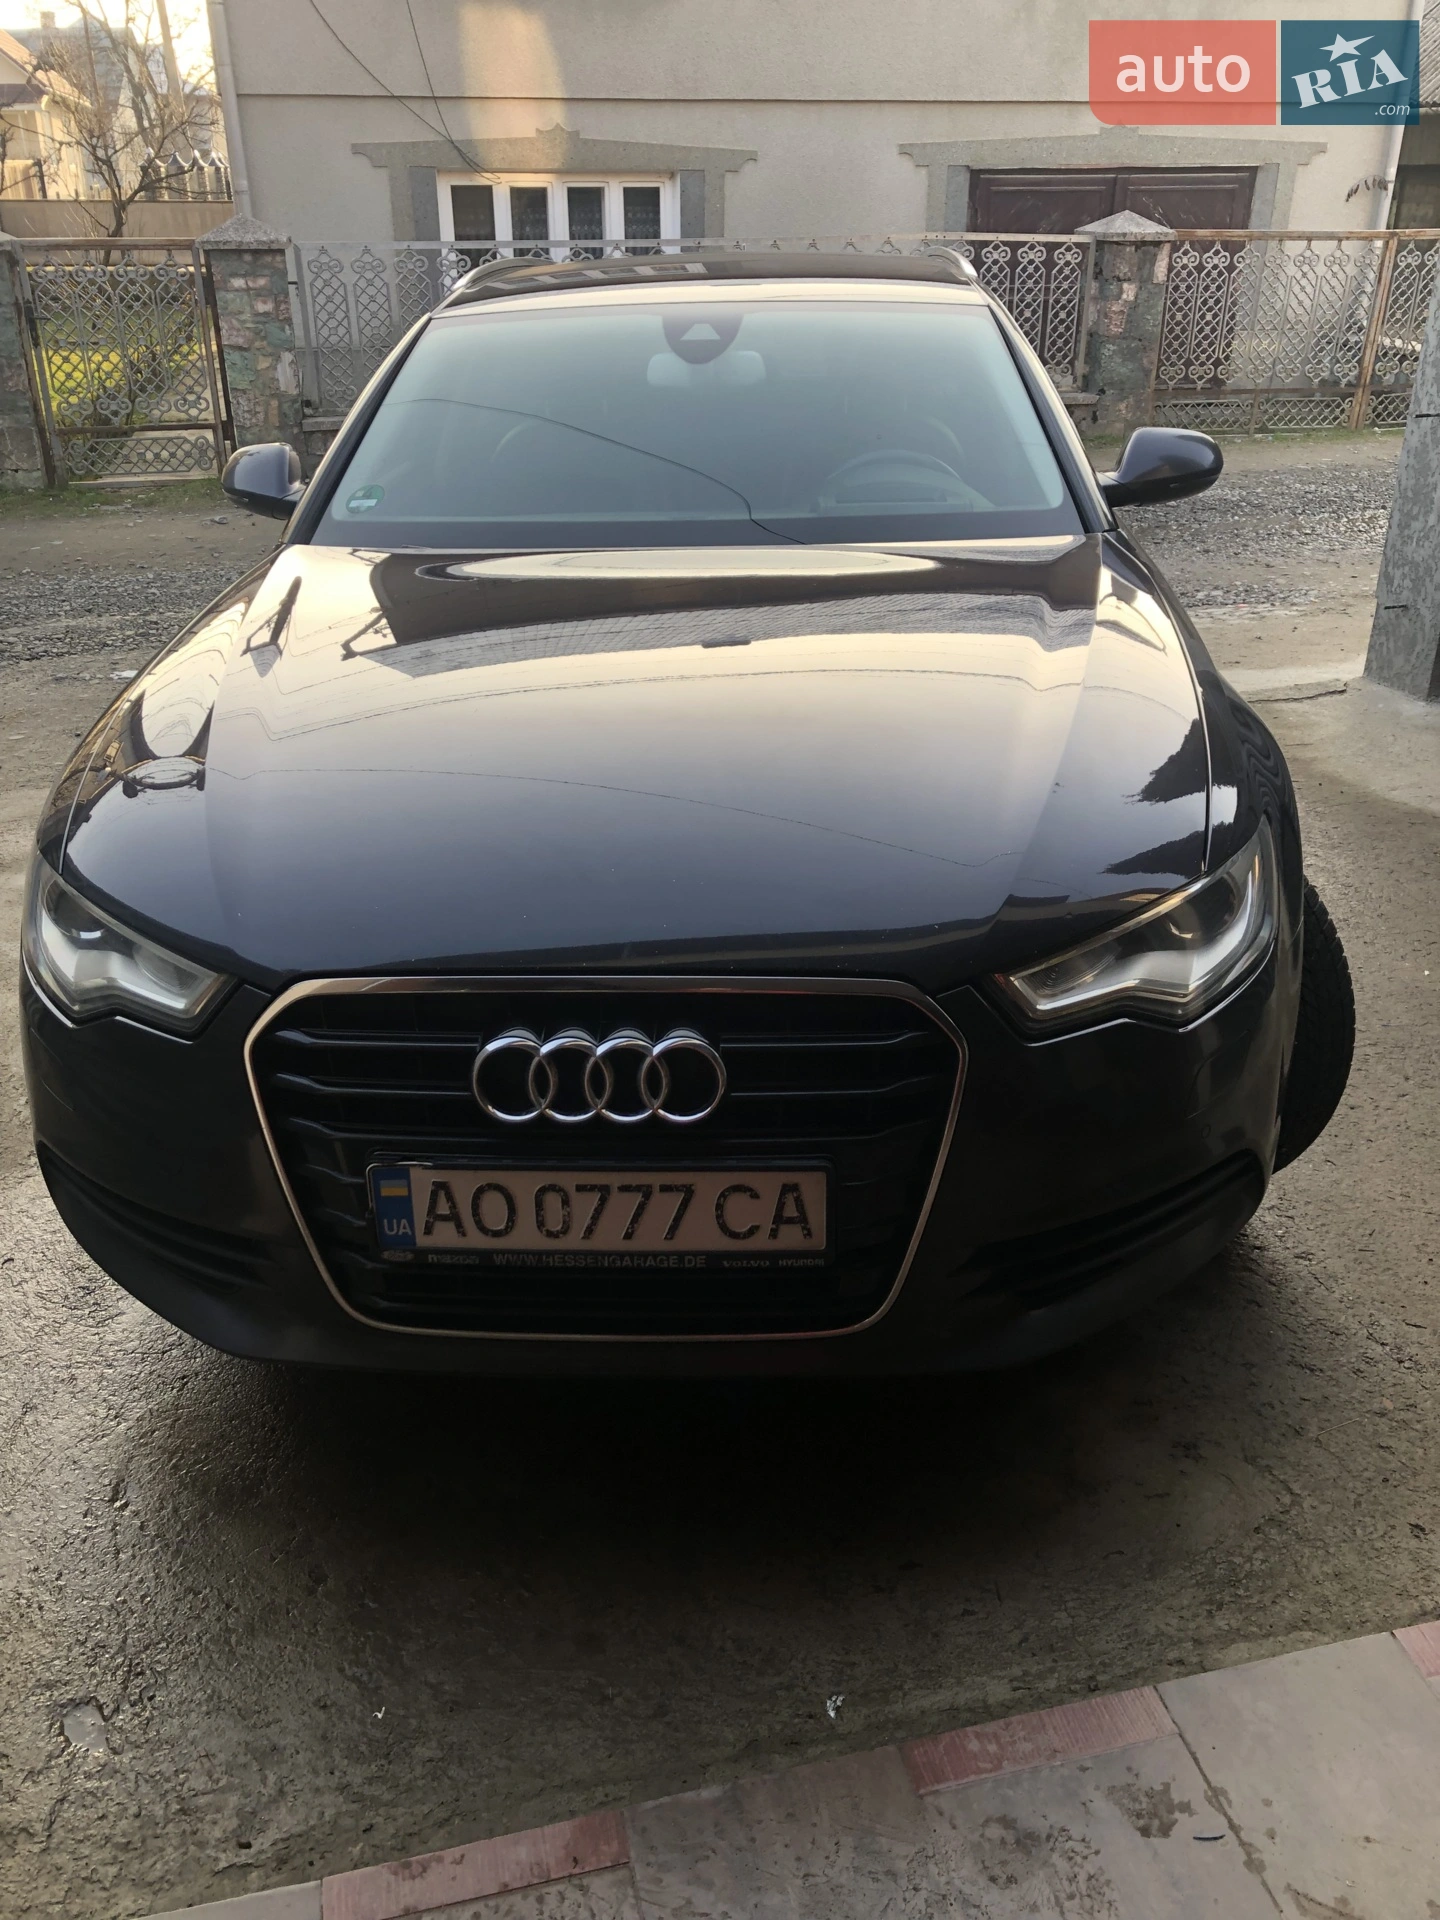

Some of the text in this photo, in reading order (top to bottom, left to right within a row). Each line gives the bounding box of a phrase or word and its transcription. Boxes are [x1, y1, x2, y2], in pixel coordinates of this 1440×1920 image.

[423, 1180, 814, 1240] AO 0777 CA
[384, 1219, 413, 1237] UA
[493, 1253, 706, 1268] WWW.HESSENGARAGE.DE
[721, 1259, 770, 1267] VOLVO
